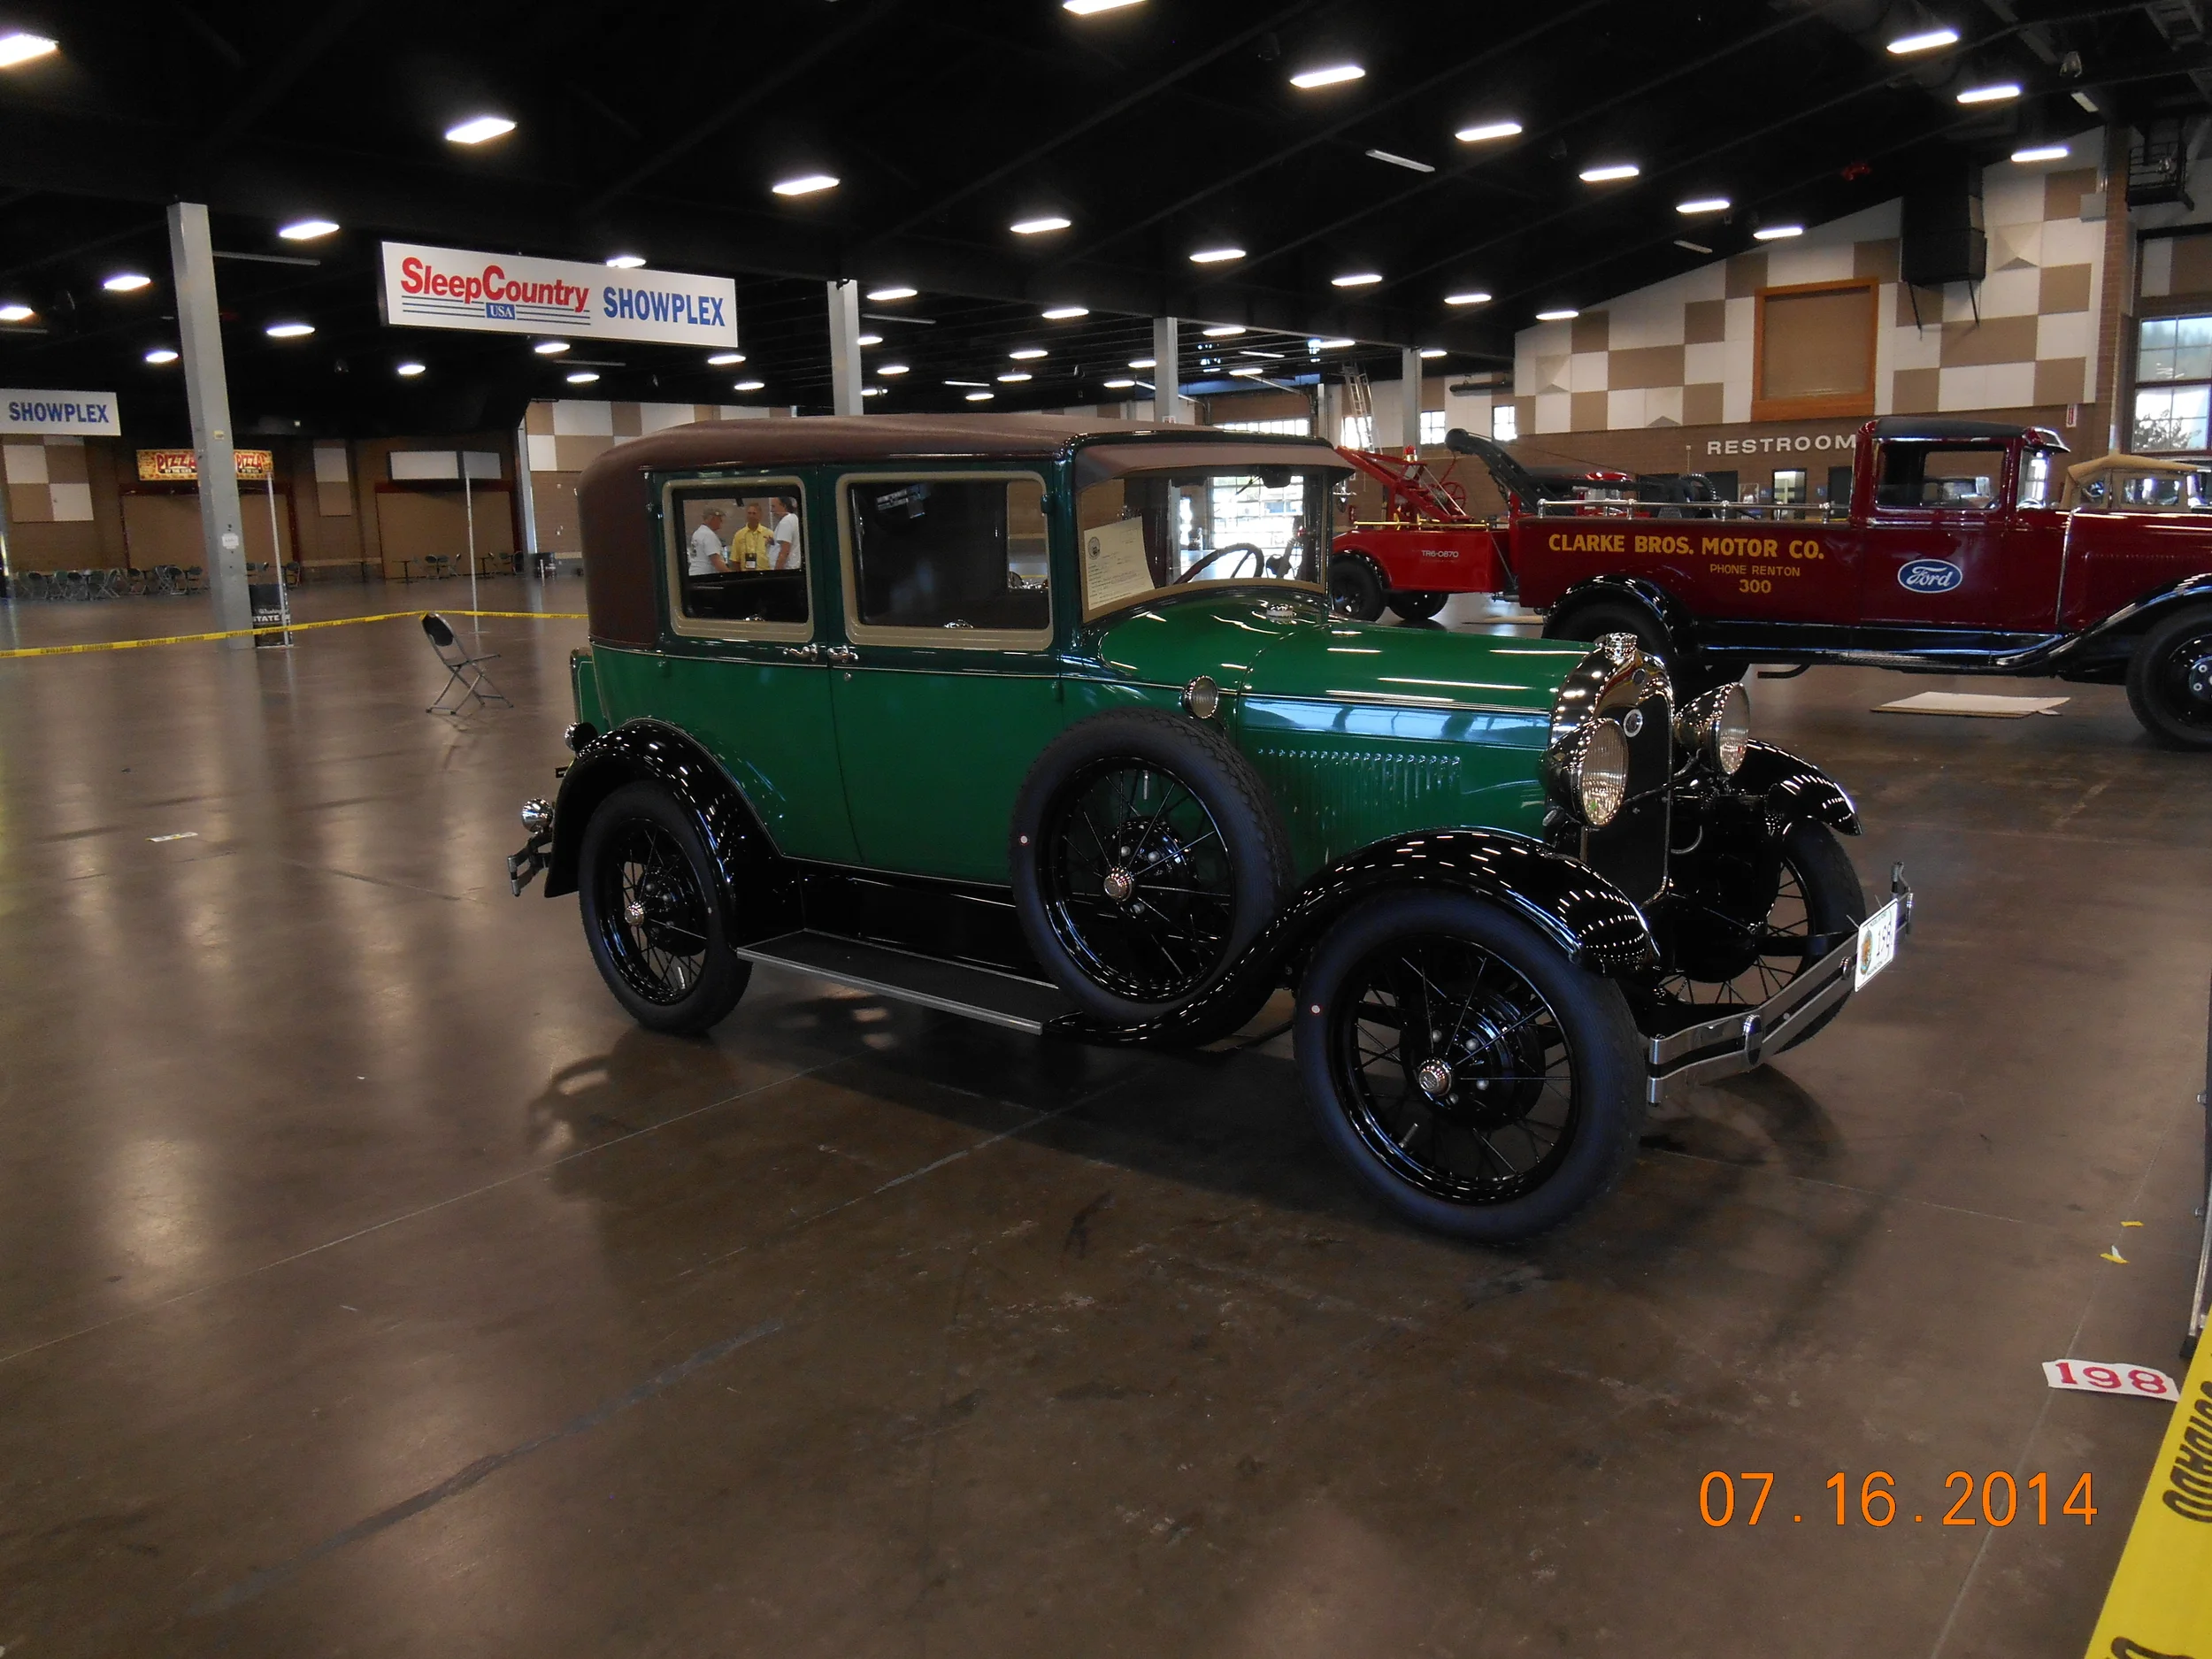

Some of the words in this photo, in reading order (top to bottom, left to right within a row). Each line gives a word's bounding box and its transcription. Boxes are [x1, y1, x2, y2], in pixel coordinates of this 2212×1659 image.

[401, 257, 589, 312] SleepCountry
[603, 287, 726, 326] SHOWPLEX
[489, 304, 513, 318] USA
[9, 401, 110, 424] SHOWPLEX
[1708, 434, 1856, 455] RESTROOM
[1549, 534, 1624, 552] CLARKE
[1634, 535, 1694, 555] BROS.
[1701, 537, 1778, 557] MOTOR
[1789, 540, 1824, 559] CO.
[1709, 564, 1747, 574] PHONE
[1752, 565, 1801, 577] RENTON
[1907, 566, 1953, 587] Ford
[1739, 580, 1771, 594] 300
[2055, 1362, 2168, 1395] 198
